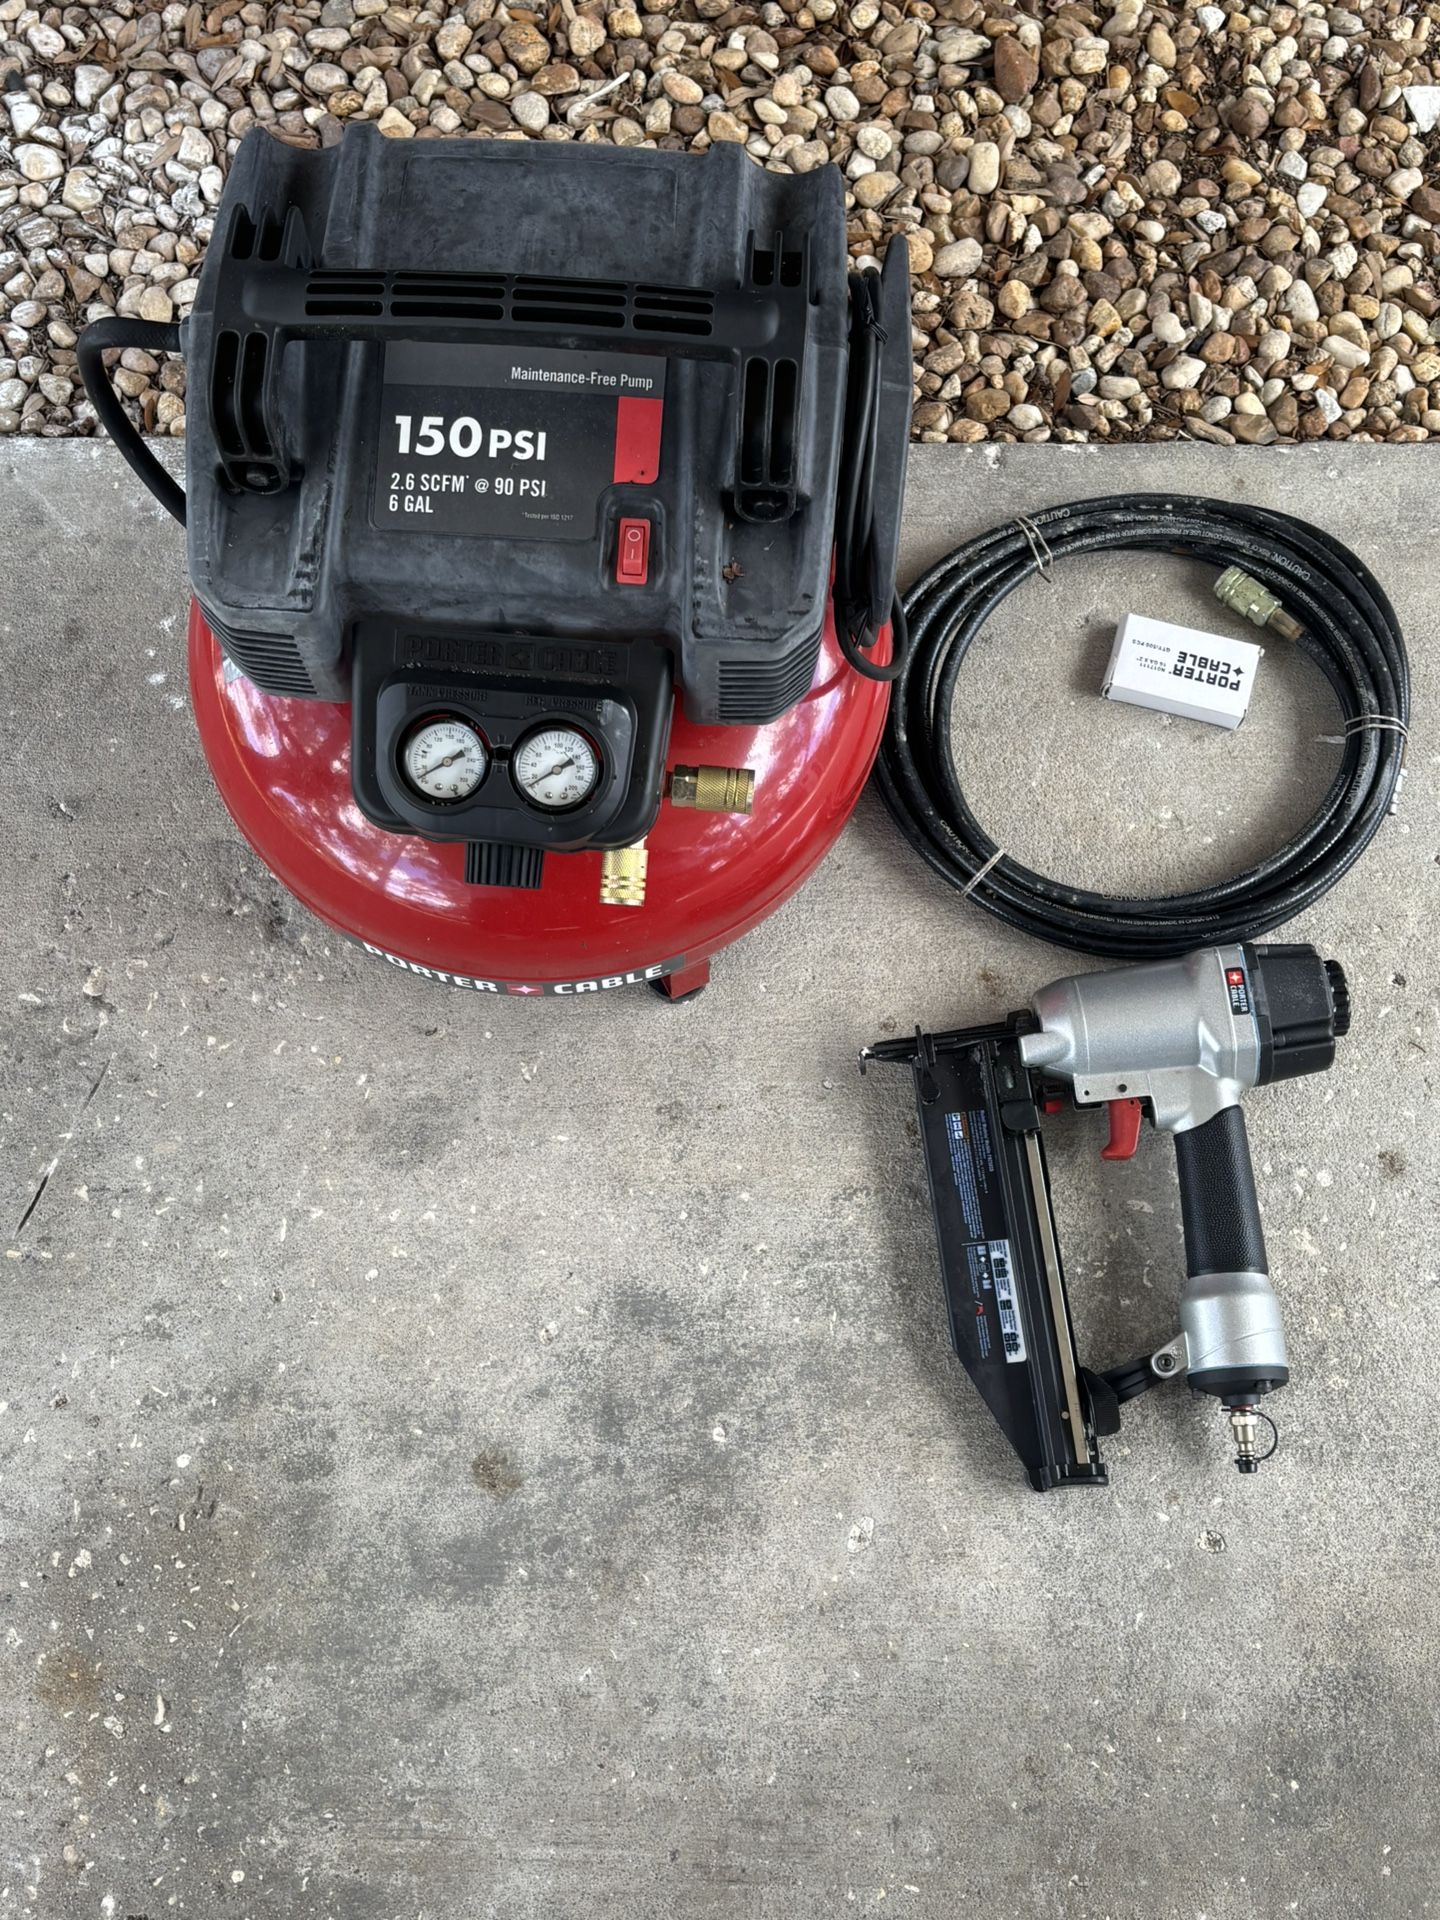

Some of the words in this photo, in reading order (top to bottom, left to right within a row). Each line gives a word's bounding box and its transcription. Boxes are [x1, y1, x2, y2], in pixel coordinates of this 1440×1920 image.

[511, 366, 616, 387] Maintenance-Free
[620, 374, 653, 390] Pump
[395, 414, 482, 458] 150
[488, 428, 547, 460] PSI
[390, 472, 415, 490] 2.6
[474, 478, 490, 494] @
[494, 478, 514, 496] 90
[519, 479, 546, 498] PSI
[388, 494, 399, 512] 6
[404, 496, 433, 513] GAL
[1177, 651, 1232, 675] CABLE
[1171, 664, 1241, 692] PORTER
[362, 942, 498, 994] PORTER
[554, 964, 662, 995] CABLE
[1238, 984, 1248, 1012] PORTER
